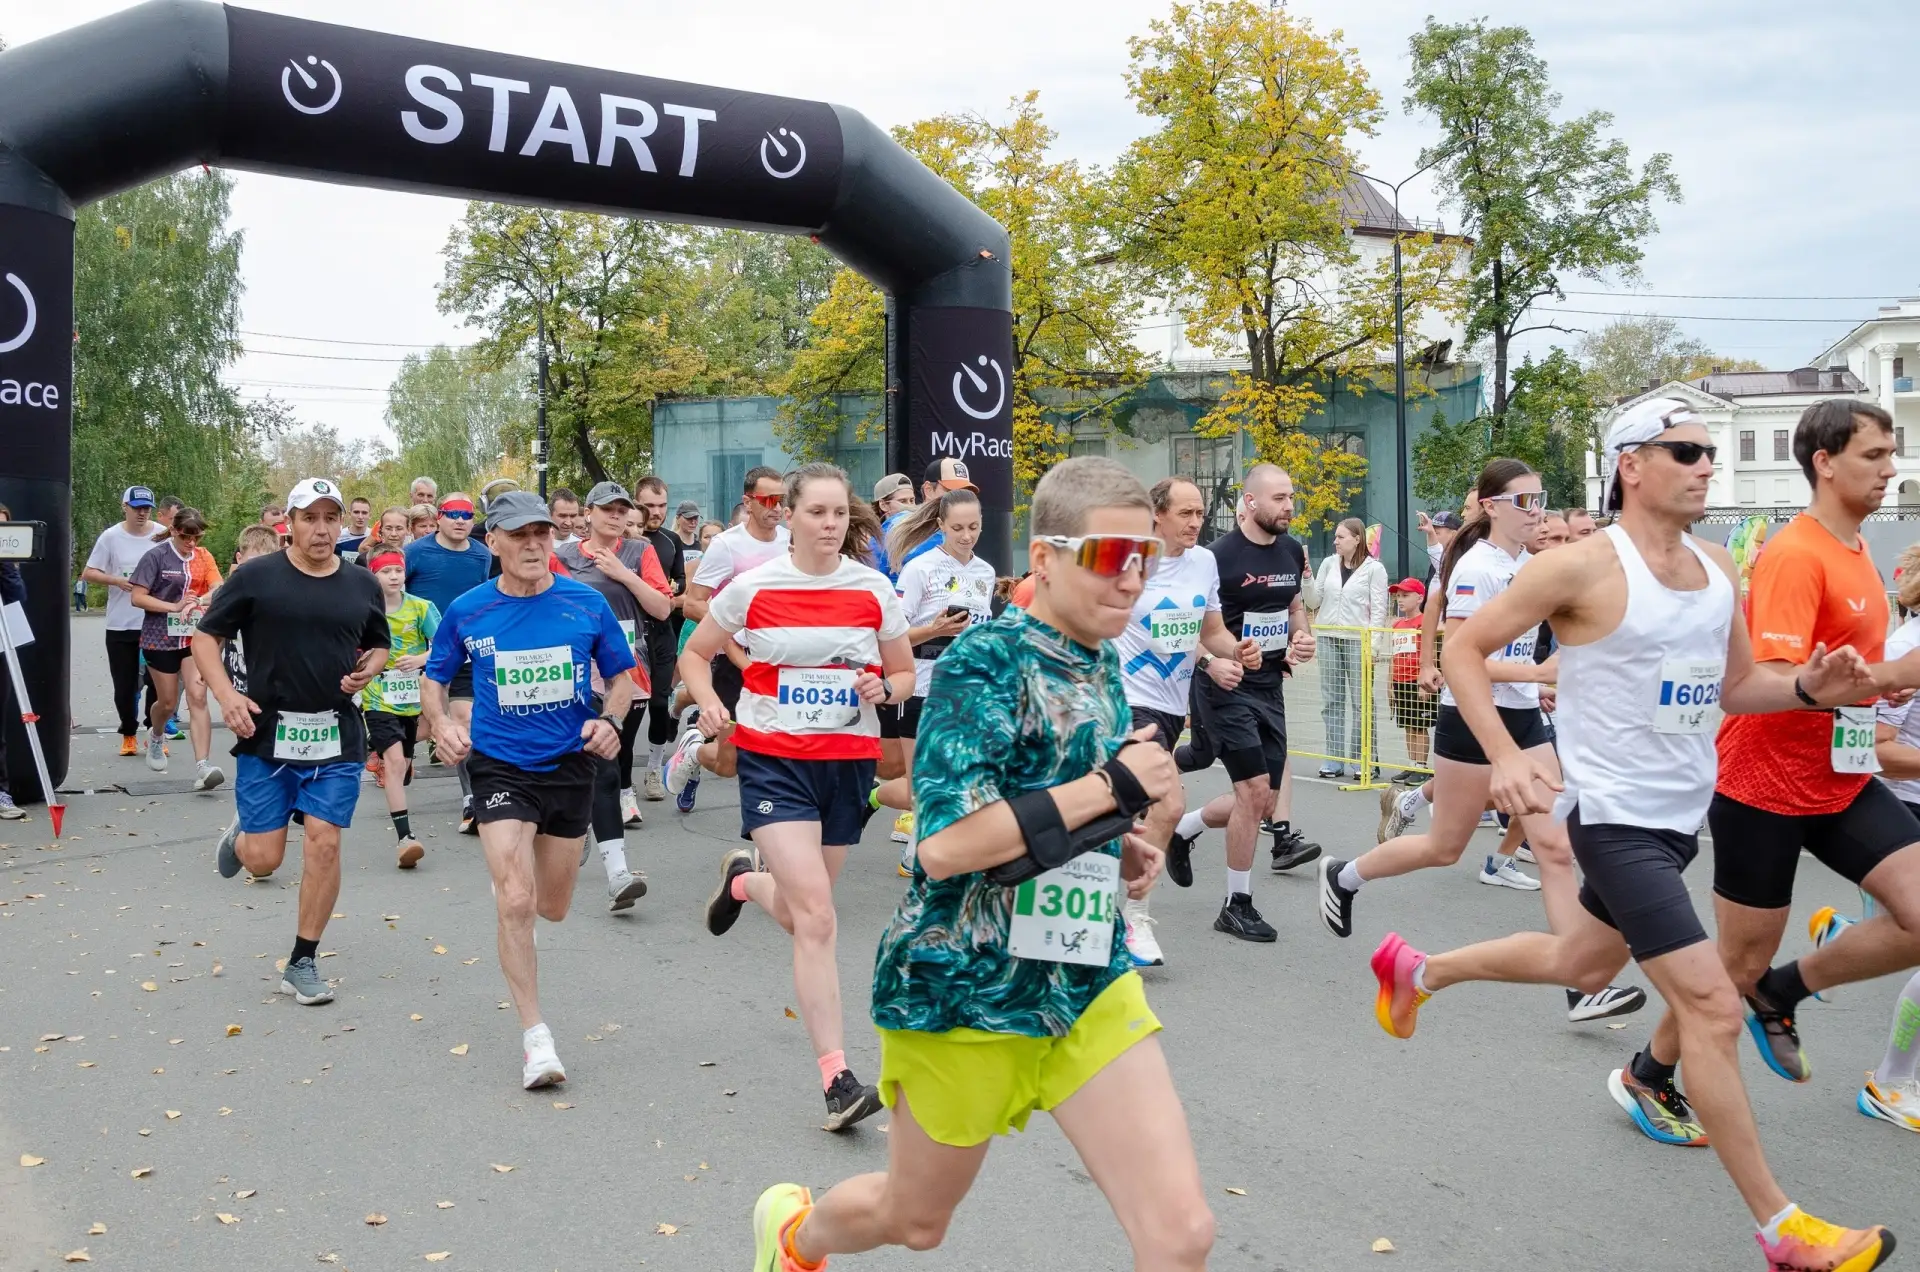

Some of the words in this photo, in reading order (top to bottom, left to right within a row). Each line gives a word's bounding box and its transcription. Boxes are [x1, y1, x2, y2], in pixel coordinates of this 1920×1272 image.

[401, 64, 717, 178] START
[931, 431, 1013, 461] MyRace
[1257, 573, 1296, 584] DEMIX
[1161, 621, 1197, 636] 3039
[1252, 624, 1283, 637] 6003
[1513, 642, 1534, 656] 602
[508, 665, 562, 684] 3028
[390, 680, 418, 691] 3051
[791, 687, 848, 706] 6034
[287, 728, 329, 742] 3019
[1064, 861, 1081, 871] РИ
[1039, 884, 1113, 924] 3018
